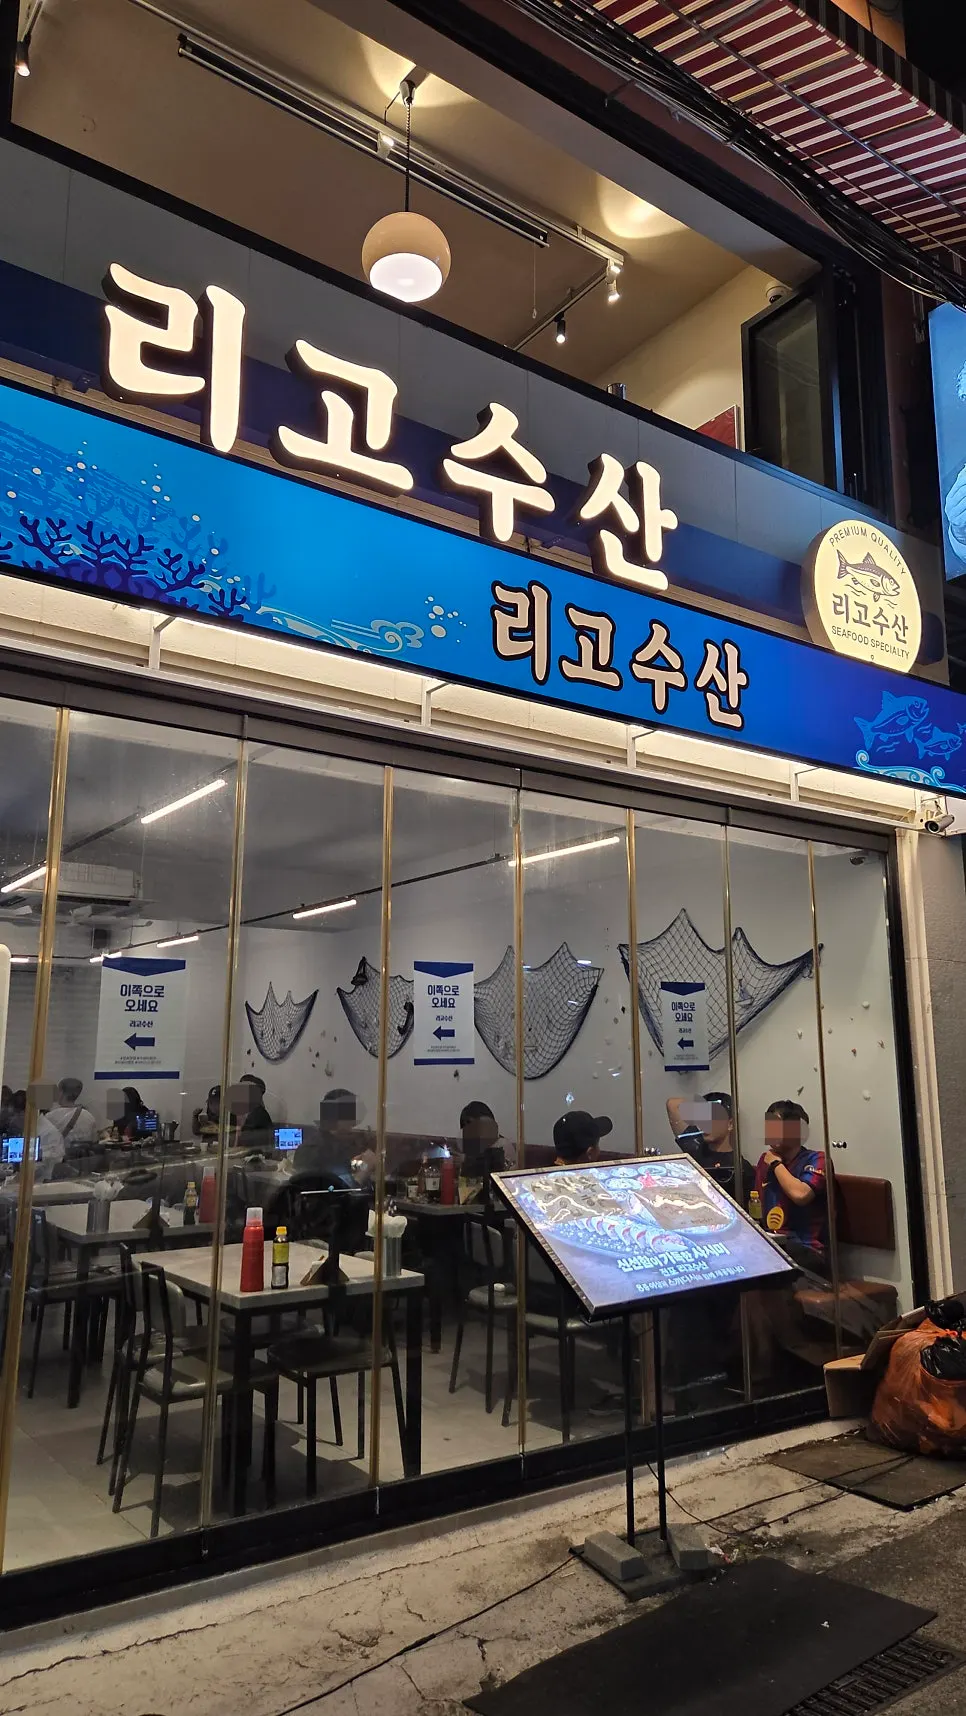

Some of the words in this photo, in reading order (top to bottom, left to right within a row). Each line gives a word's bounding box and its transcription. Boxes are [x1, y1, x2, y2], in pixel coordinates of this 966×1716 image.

[105, 262, 678, 590] 리고수산
[829, 526, 868, 547] PREMIUM
[870, 533, 906, 575] QUALITY
[832, 593, 909, 644] 리고수산
[831, 625, 869, 646] SEAFOOD
[870, 639, 910, 660] SPECIALTY
[491, 581, 749, 729] 리고수산
[120, 984, 164, 998] 이쪽으로
[427, 984, 460, 996] 이쪽으로
[124, 999, 158, 1012] 오세요
[431, 997, 456, 1008] 오세요
[671, 1001, 696, 1012] 이쪽으로
[675, 1012, 693, 1022] 오세요
[617, 1252, 663, 1273] 신선함이
[662, 1250, 695, 1266] 가득한
[692, 1242, 731, 1260] 사시미
[677, 1261, 709, 1273] 리고수산
